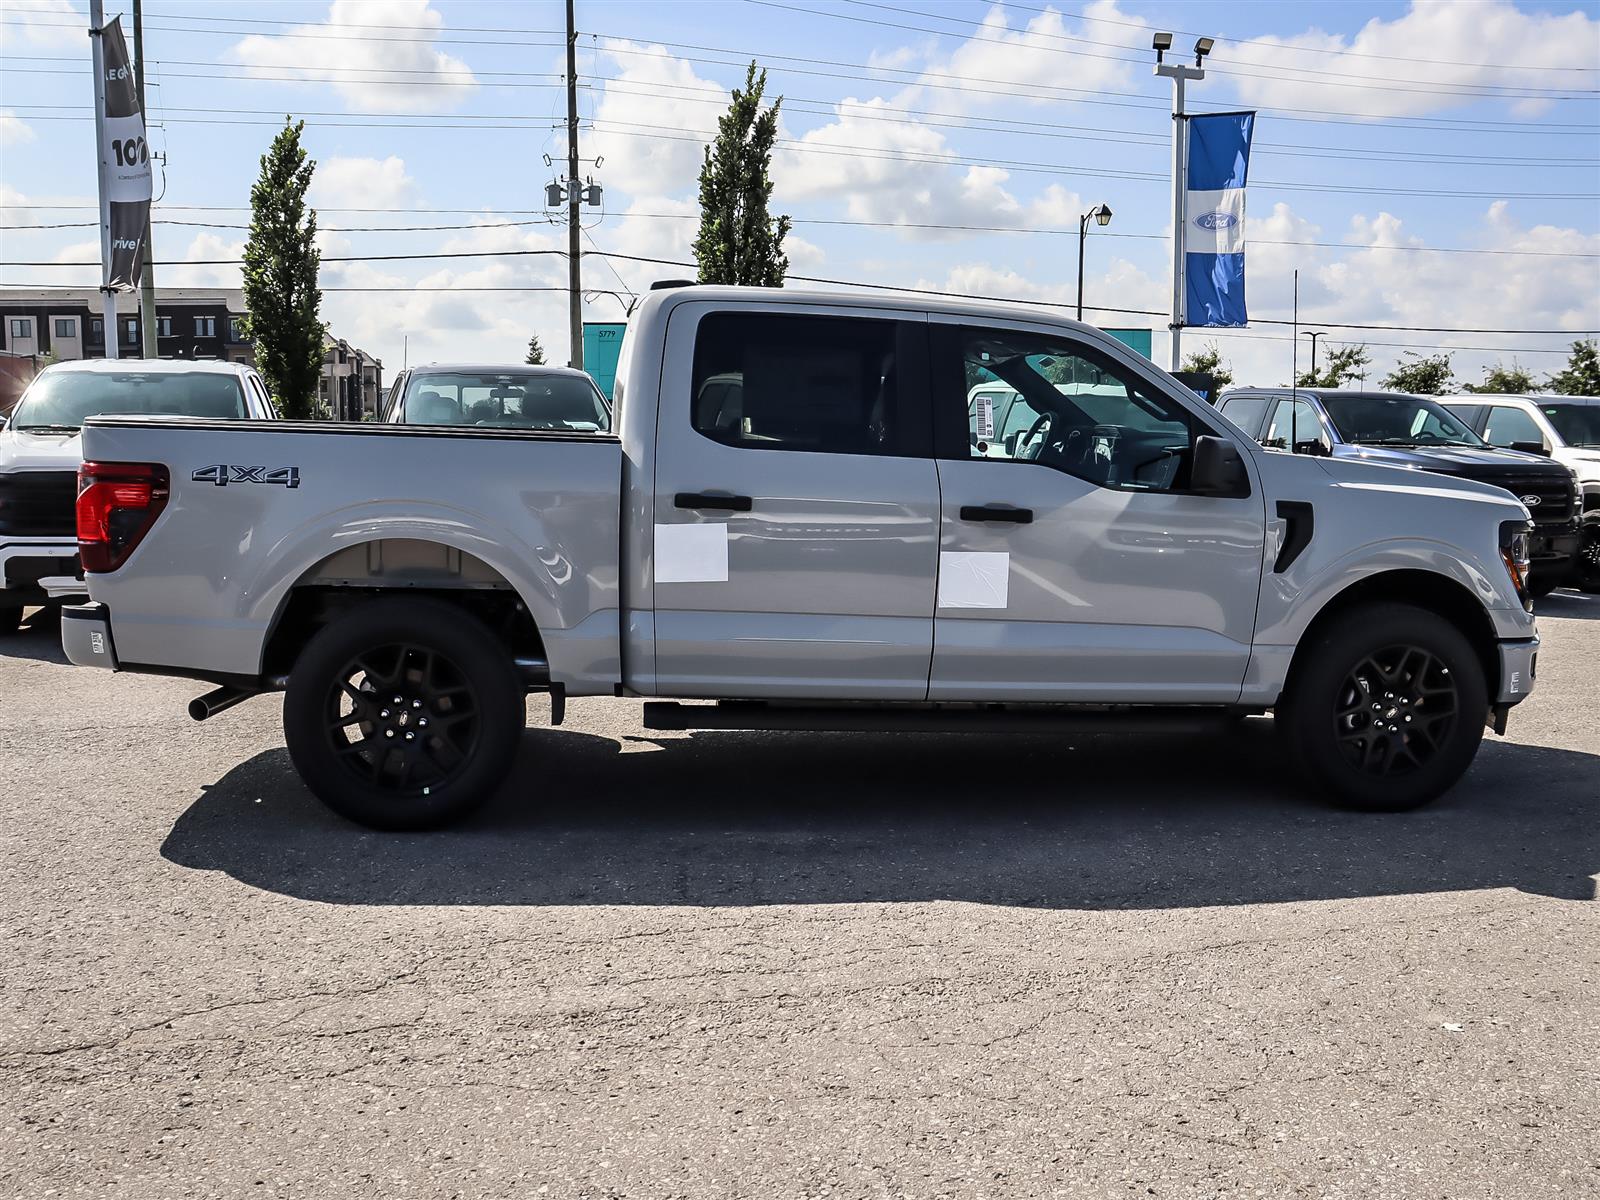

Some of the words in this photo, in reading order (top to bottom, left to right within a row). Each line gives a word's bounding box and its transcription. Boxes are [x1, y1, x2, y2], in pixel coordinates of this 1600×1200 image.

[112, 136, 148, 167] 100
[1204, 214, 1229, 228] Ford
[599, 330, 616, 338] 5779
